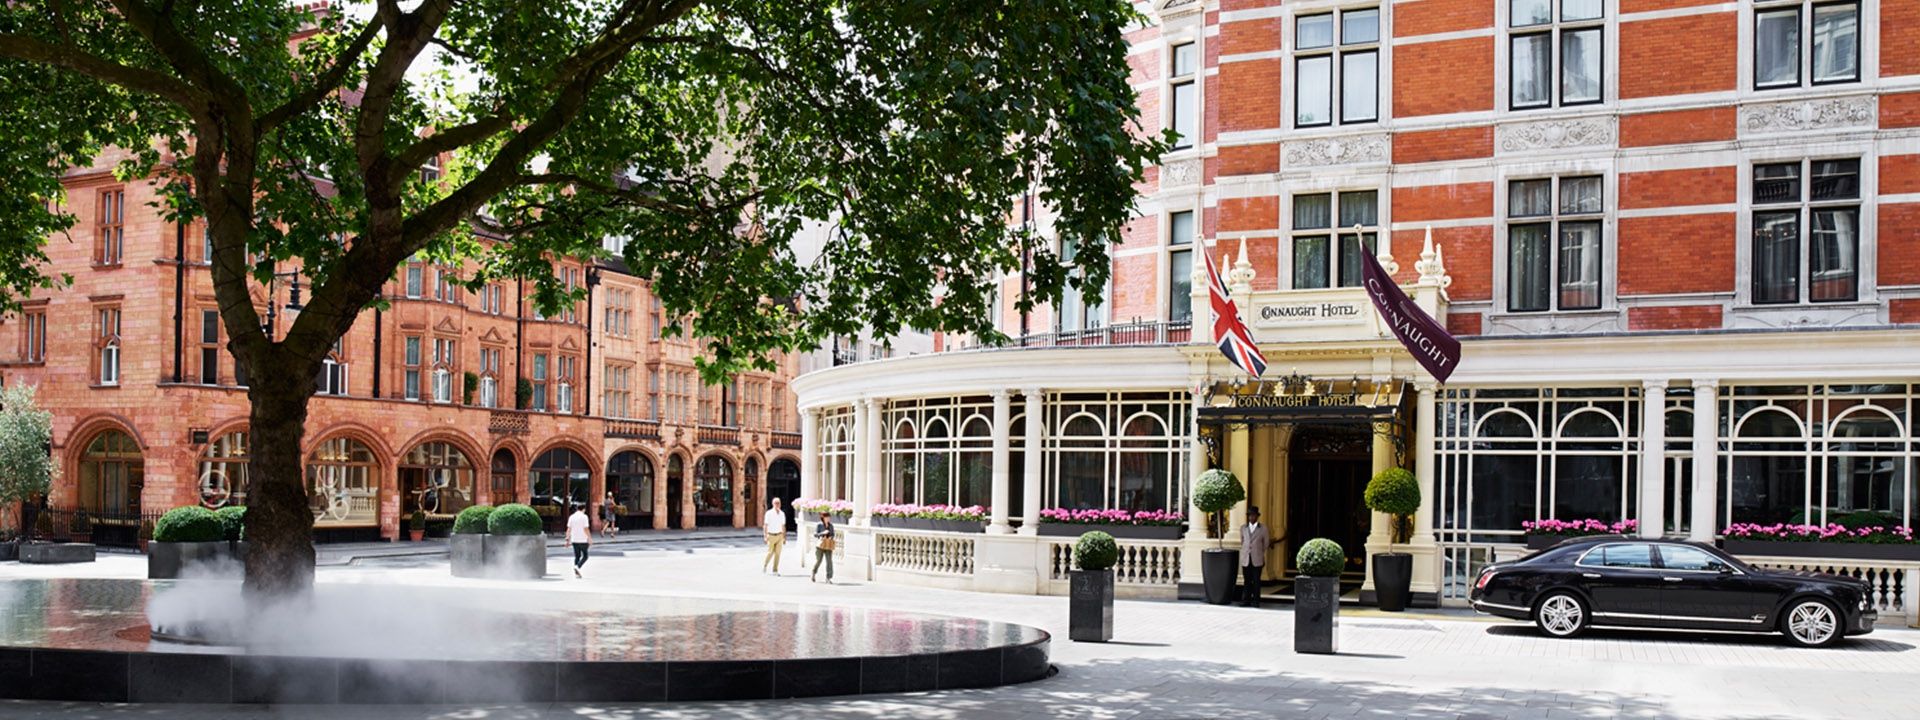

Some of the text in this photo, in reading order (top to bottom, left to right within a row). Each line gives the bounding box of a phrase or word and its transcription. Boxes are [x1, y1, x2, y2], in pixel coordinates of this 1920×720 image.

[1261, 303, 1359, 320] CONNAUGHT HOTEL
[1237, 395, 1355, 408] CONNAUGHT HOTEL
